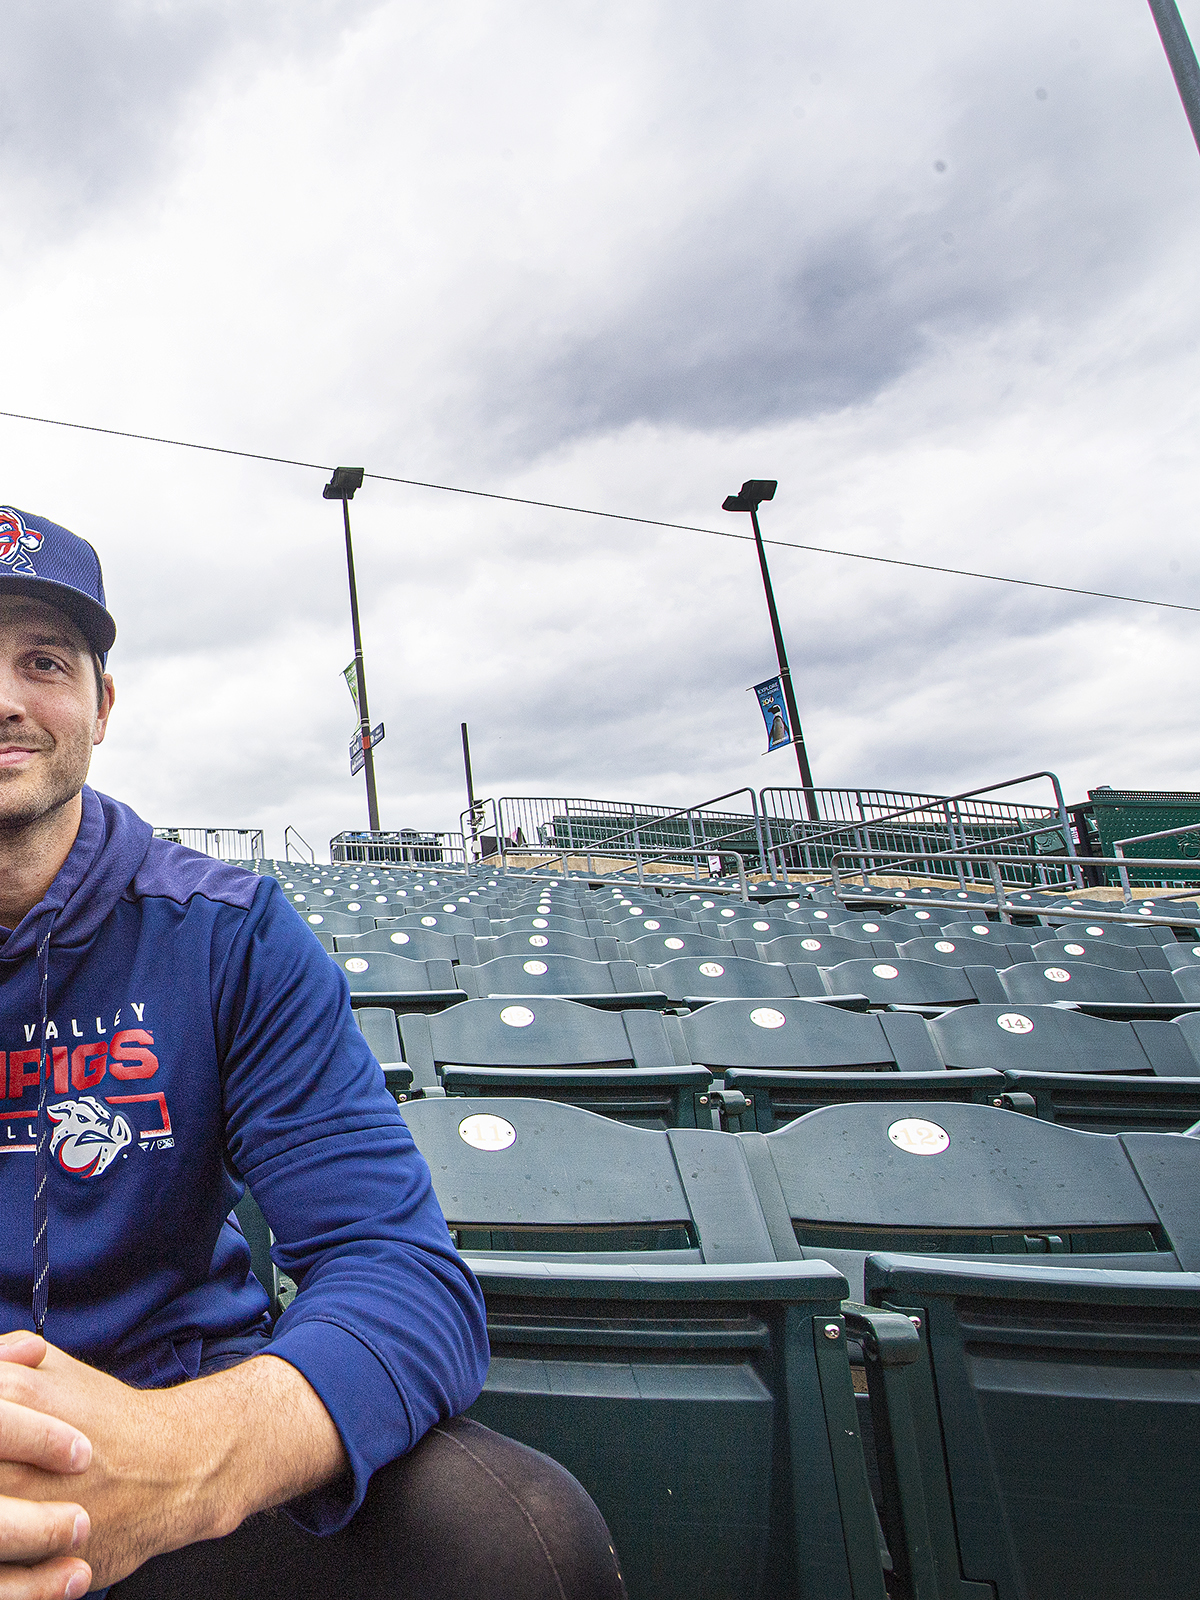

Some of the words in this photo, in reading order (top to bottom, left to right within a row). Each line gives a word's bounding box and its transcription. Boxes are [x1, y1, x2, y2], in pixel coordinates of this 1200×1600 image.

[757, 682, 779, 695] EXPLORE
[23, 1002, 145, 1043] VALLEY
[758, 1013, 778, 1023] 13
[1005, 1018, 1026, 1029] 14
[473, 1123, 503, 1142] 11
[899, 1127, 938, 1145] 12
